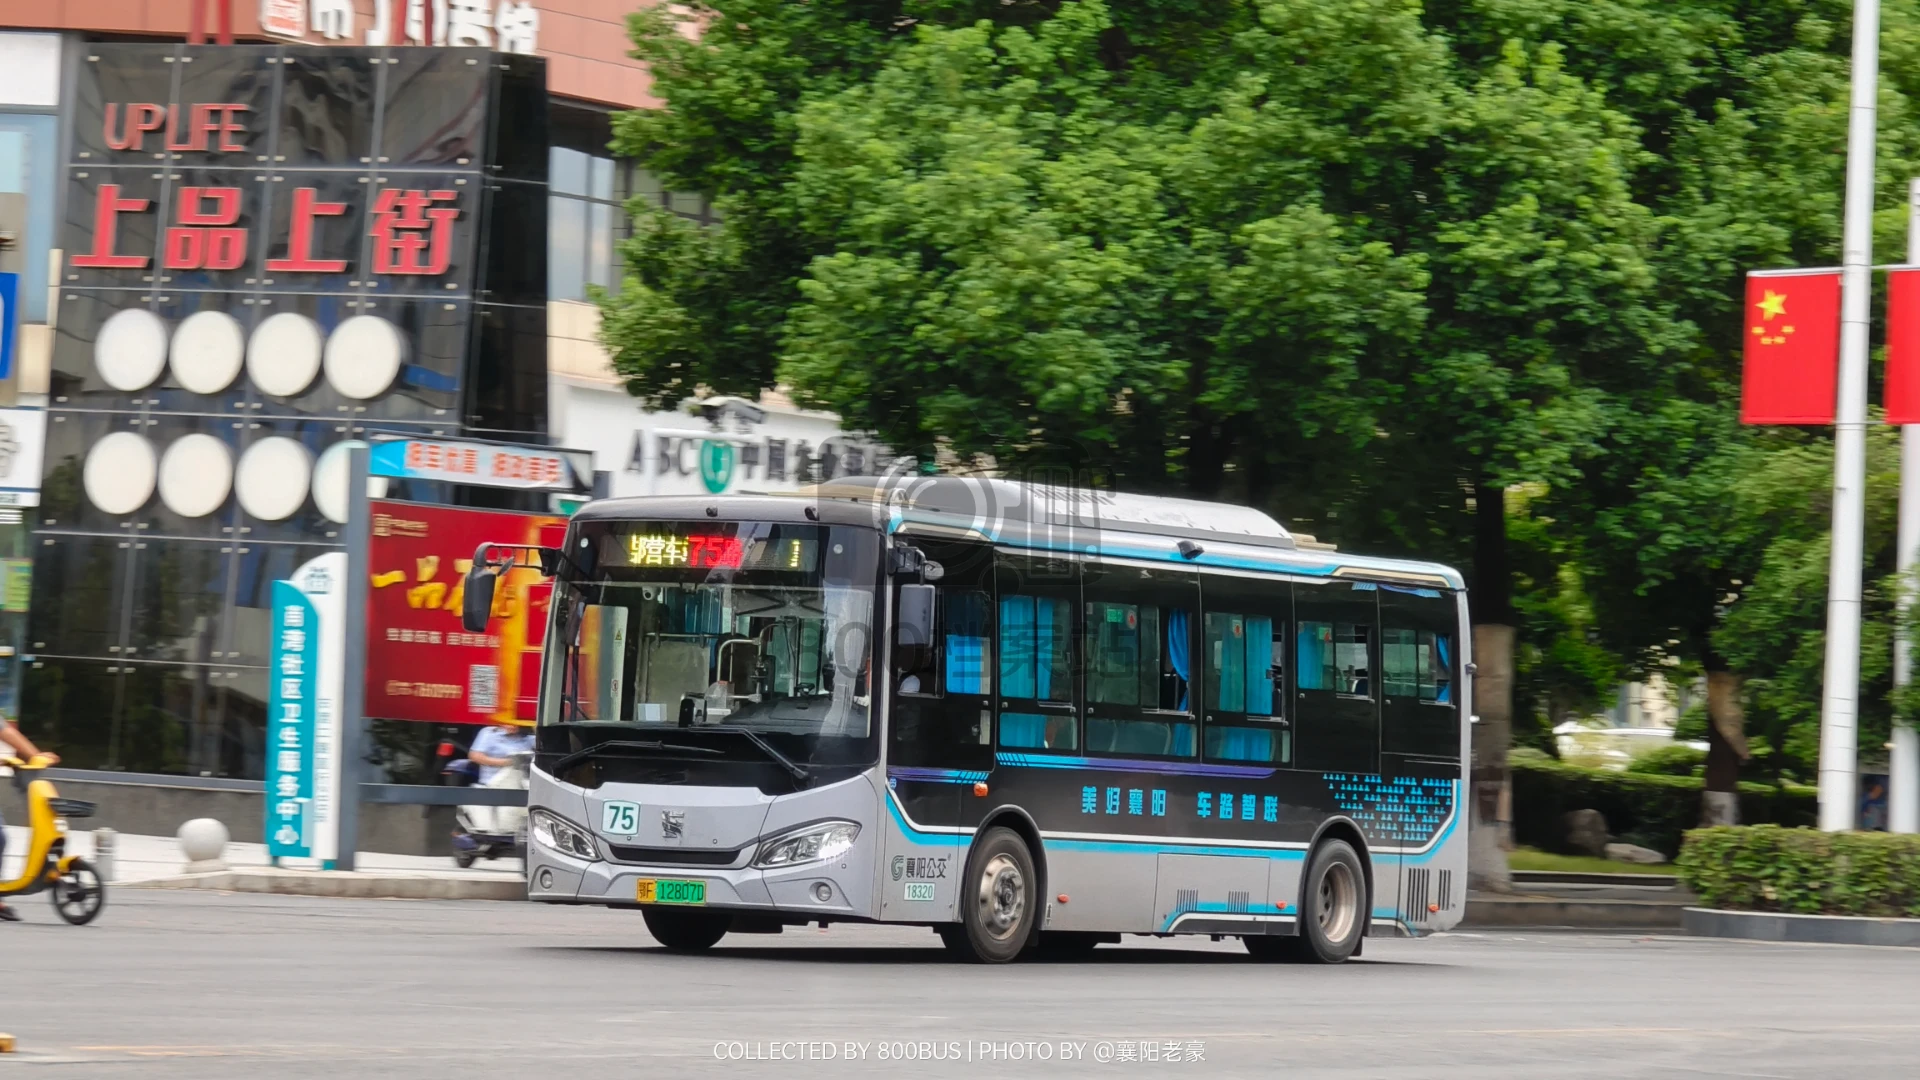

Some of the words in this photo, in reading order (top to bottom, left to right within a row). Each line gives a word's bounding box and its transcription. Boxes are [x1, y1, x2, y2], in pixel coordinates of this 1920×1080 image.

[69, 183, 461, 275] 上品上街
[625, 430, 697, 476] ABC
[608, 805, 635, 831] 75
[1081, 786, 1167, 816] 美好襄阳
[1197, 791, 1279, 822] 车路智联
[906, 857, 947, 878] 襄阳公交
[907, 885, 934, 899] 18320
